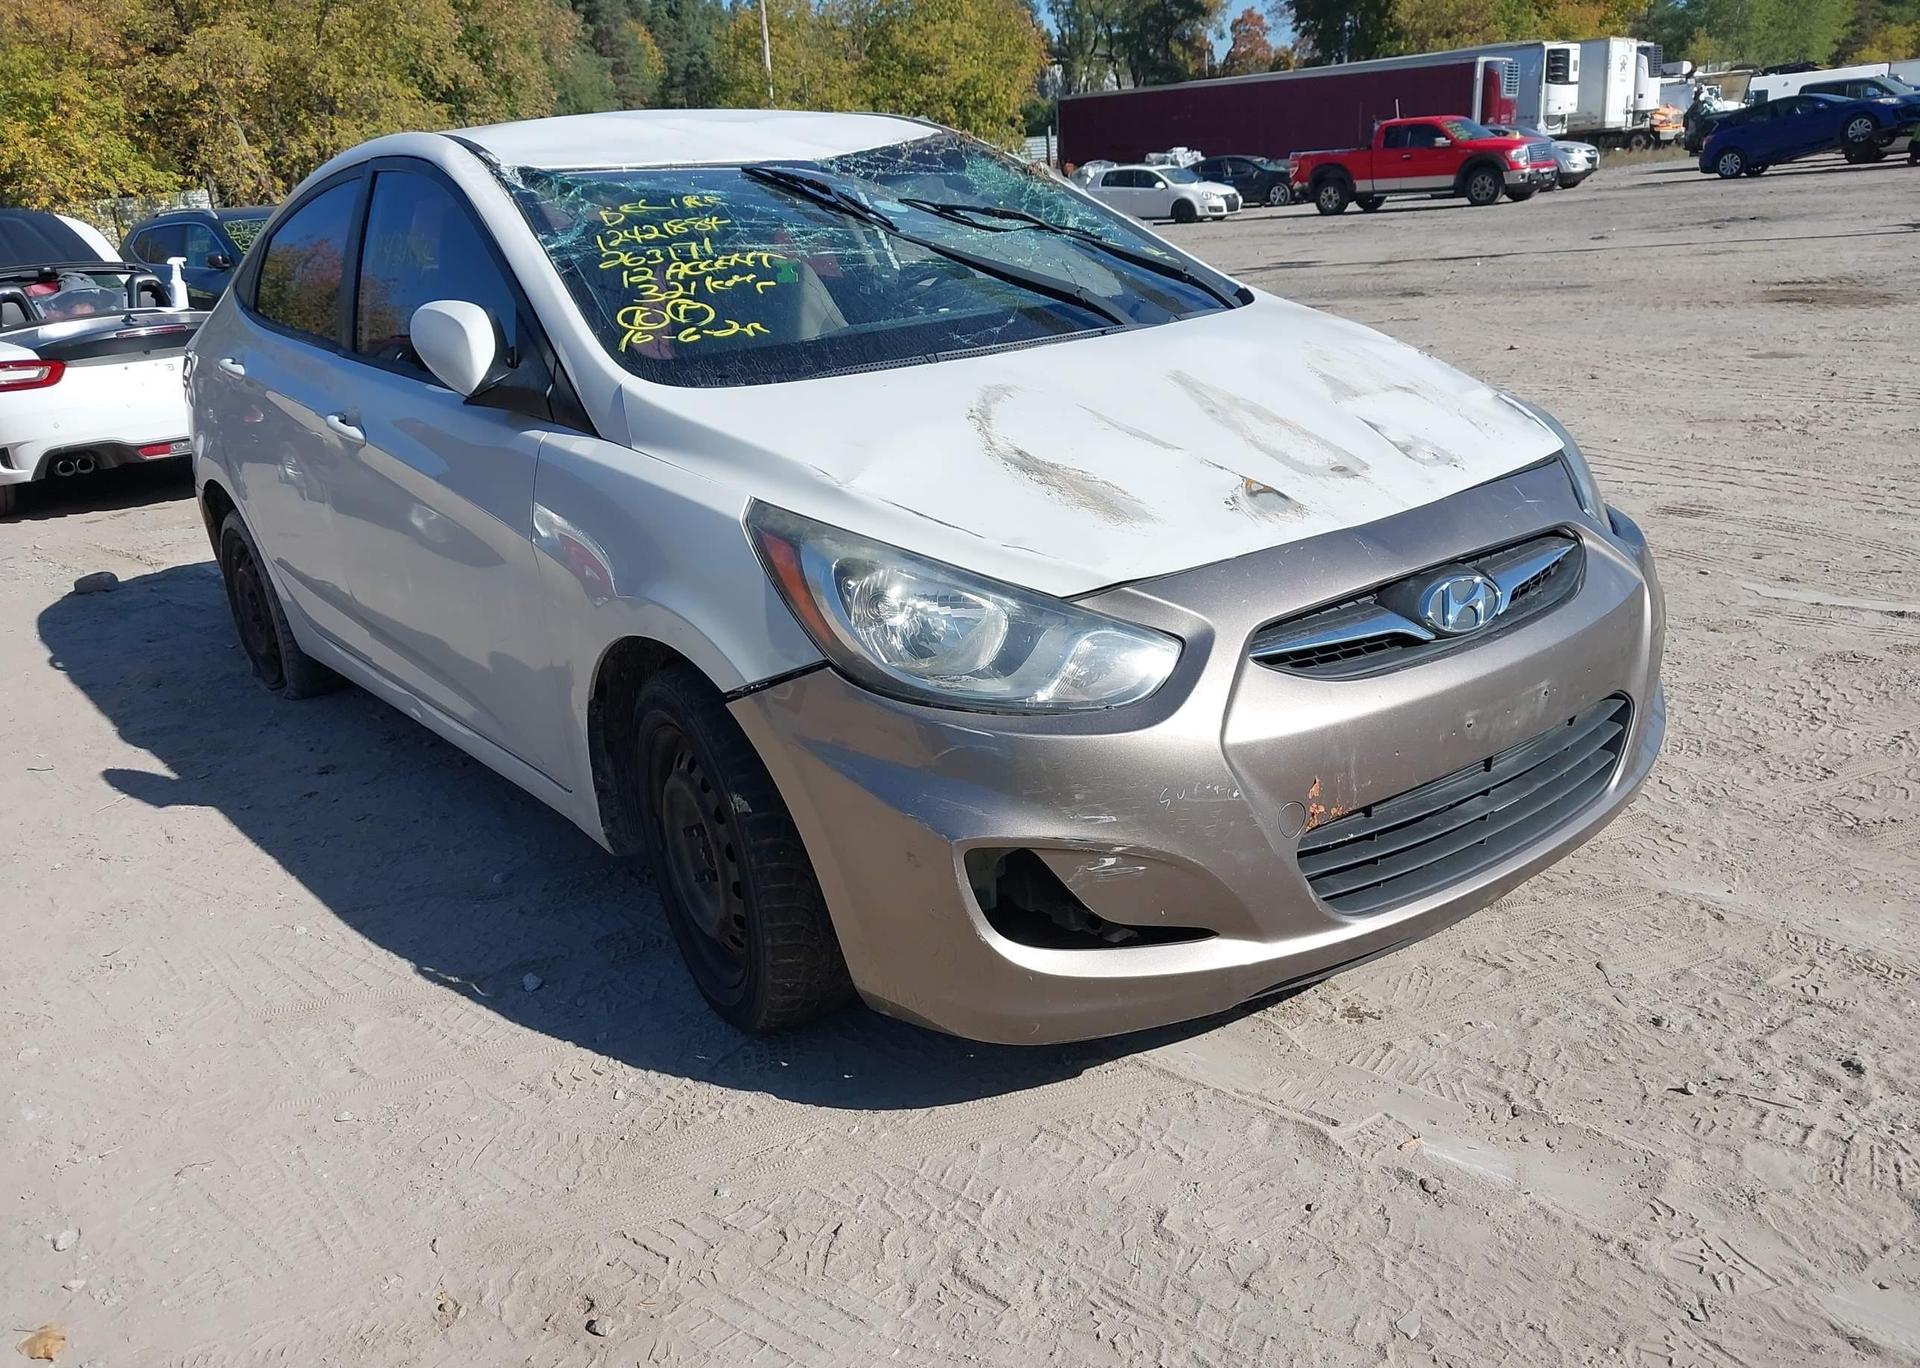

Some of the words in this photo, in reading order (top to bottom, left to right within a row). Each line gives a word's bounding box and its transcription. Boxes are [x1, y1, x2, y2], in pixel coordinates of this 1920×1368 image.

[623, 267, 658, 288] 12
[665, 251, 788, 281] ACCENT
[633, 281, 696, 303] 321
